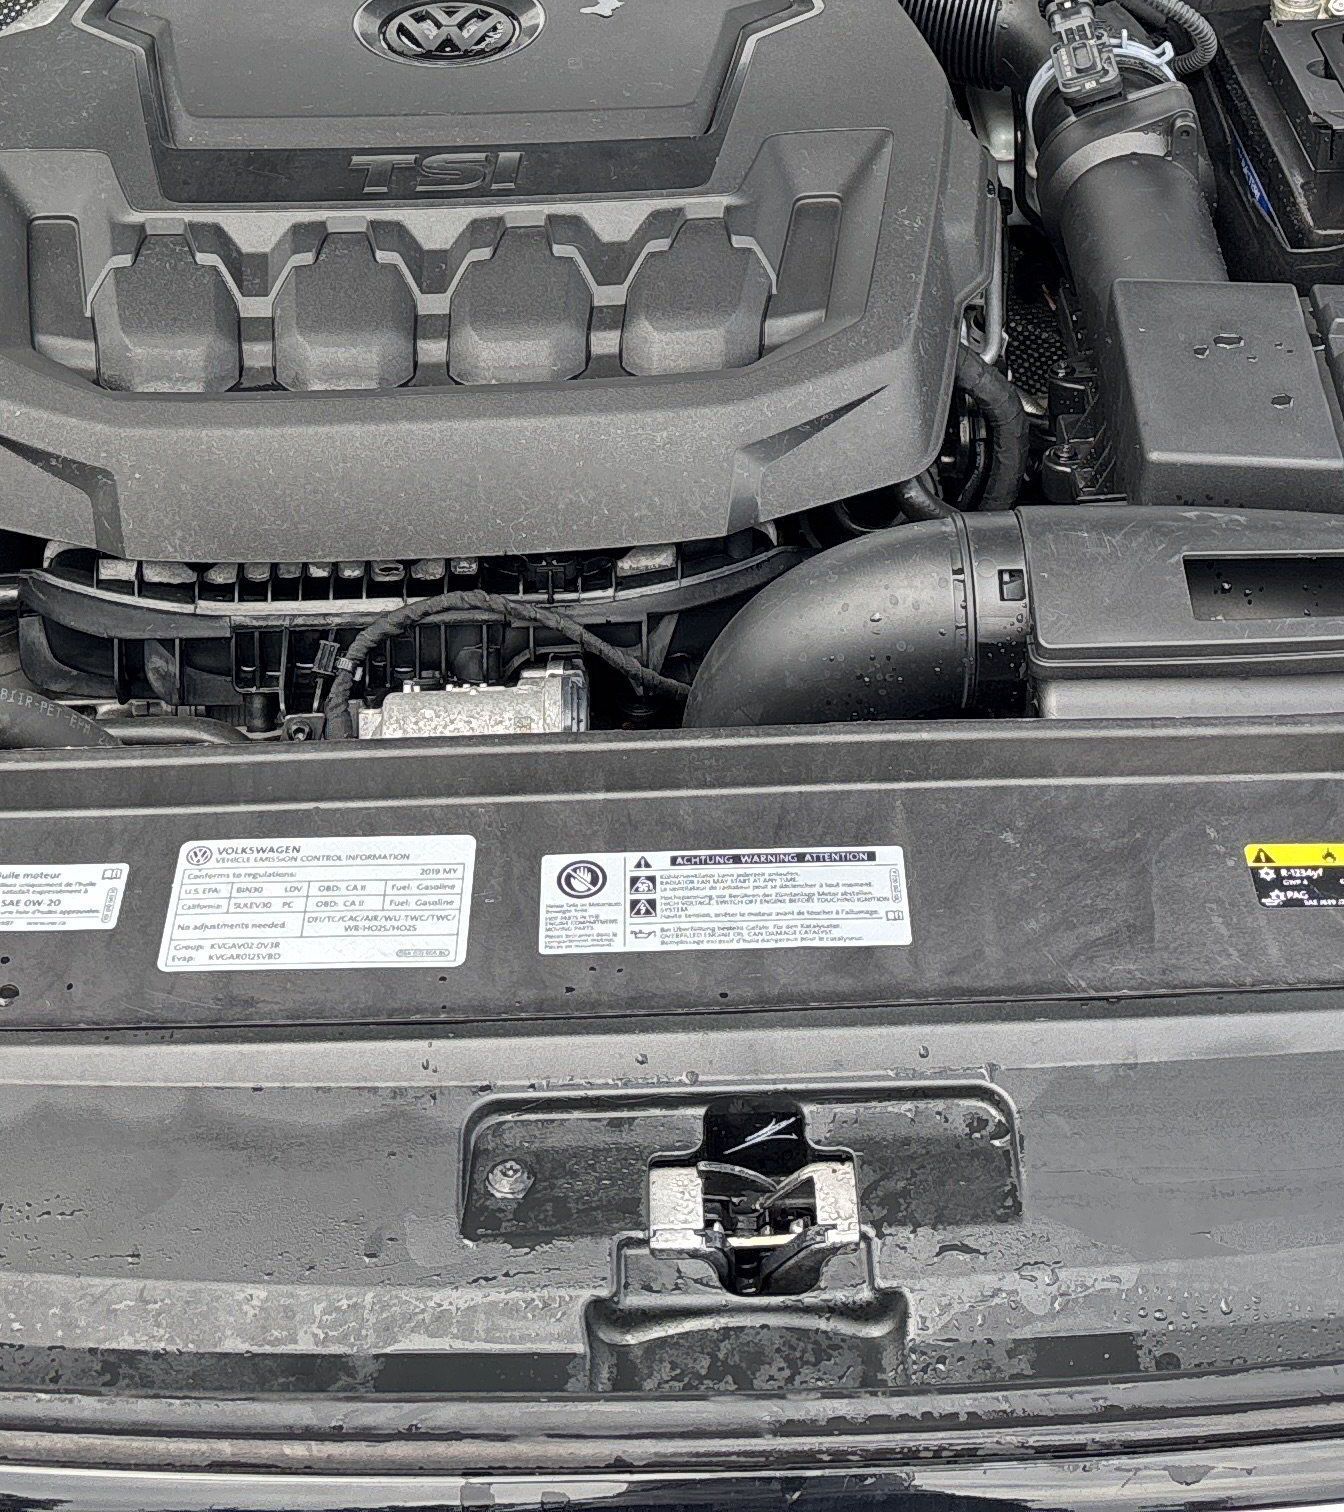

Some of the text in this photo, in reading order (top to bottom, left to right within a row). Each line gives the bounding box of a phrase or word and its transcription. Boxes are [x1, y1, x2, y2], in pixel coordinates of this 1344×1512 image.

[348, 150, 525, 194] TSI
[217, 846, 301, 855] VOLKSWAGEN
[254, 855, 297, 863] EMISSION
[300, 854, 343, 862] CONTROL
[345, 853, 410, 861] INFORMATION
[675, 852, 868, 865] ACHTUNG WARNING ATTENTION
[420, 868, 440, 876] 2019
[1280, 868, 1323, 879] R-1234yf
[1286, 891, 1309, 899] PAG
[1, 899, 21, 907] SAE
[24, 899, 61, 907] 0W-20
[192, 923, 249, 932] adjustments
